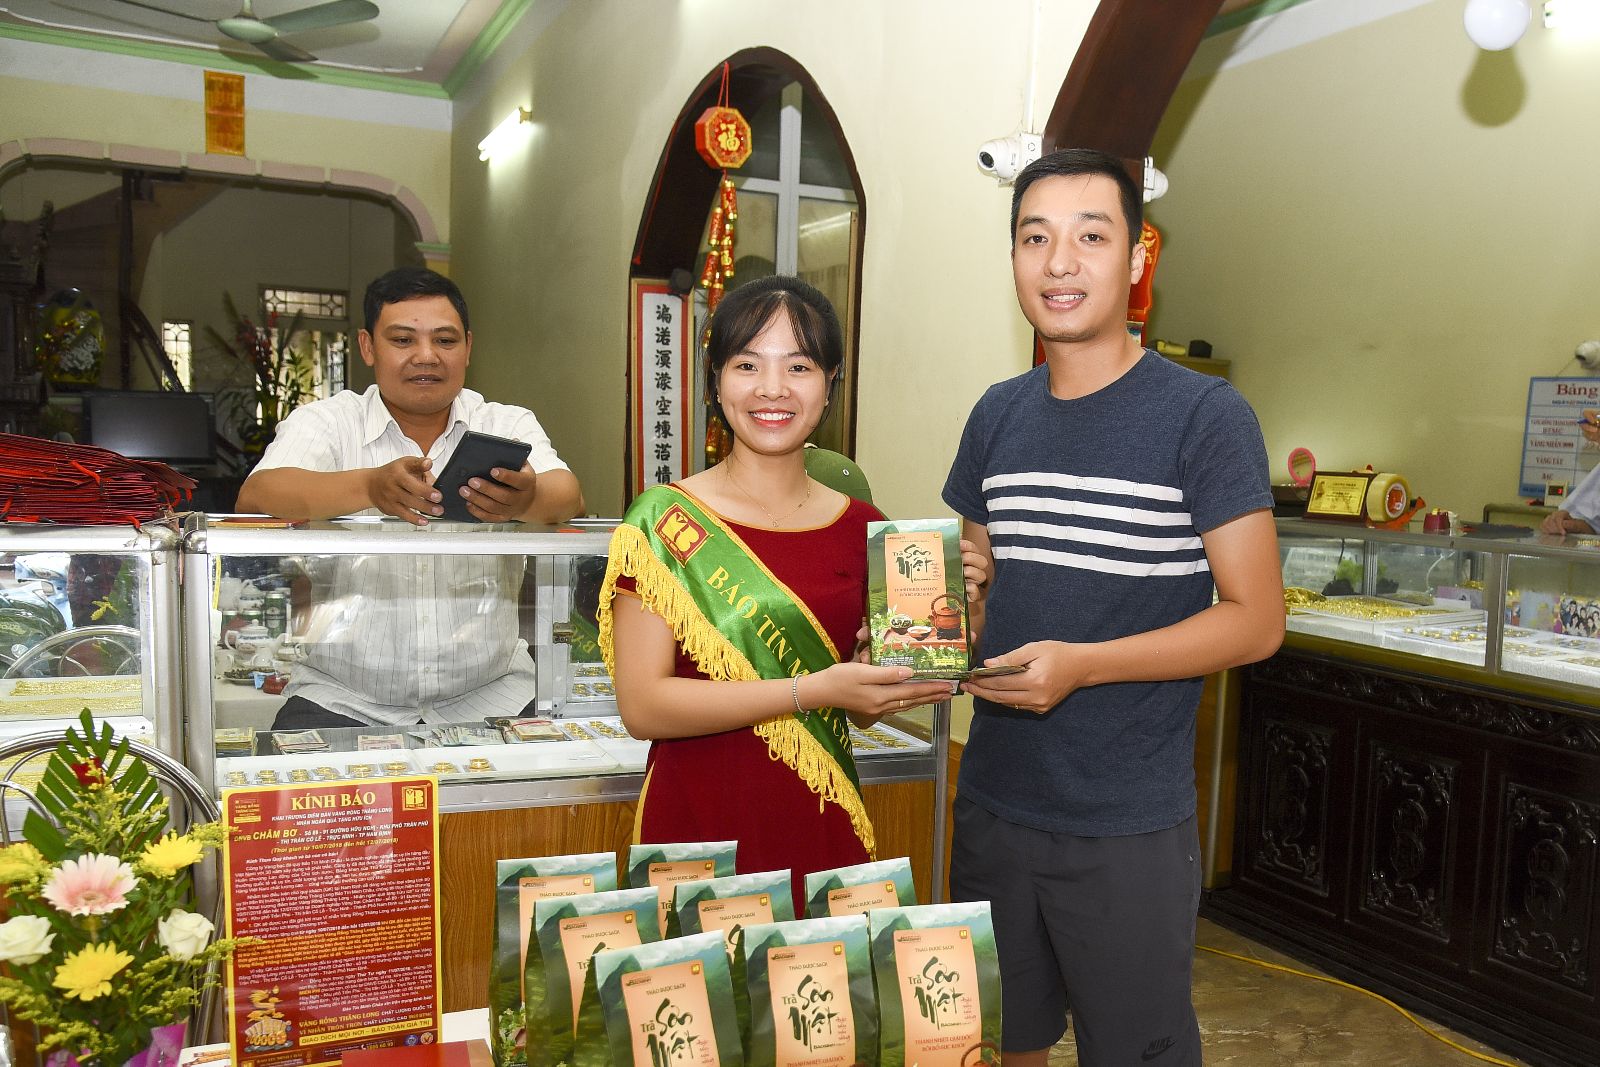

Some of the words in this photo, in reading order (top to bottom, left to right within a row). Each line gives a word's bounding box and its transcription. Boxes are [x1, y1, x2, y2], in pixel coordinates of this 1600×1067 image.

[1556, 383, 1598, 399] Bảng
[706, 565, 758, 619] BẢO
[756, 614, 793, 663] TÍN
[290, 790, 336, 810] KÍNH
[341, 788, 375, 806] BÁO
[908, 974, 922, 985] Trà
[781, 993, 798, 1005] Trà
[640, 1020, 656, 1032] Trà
